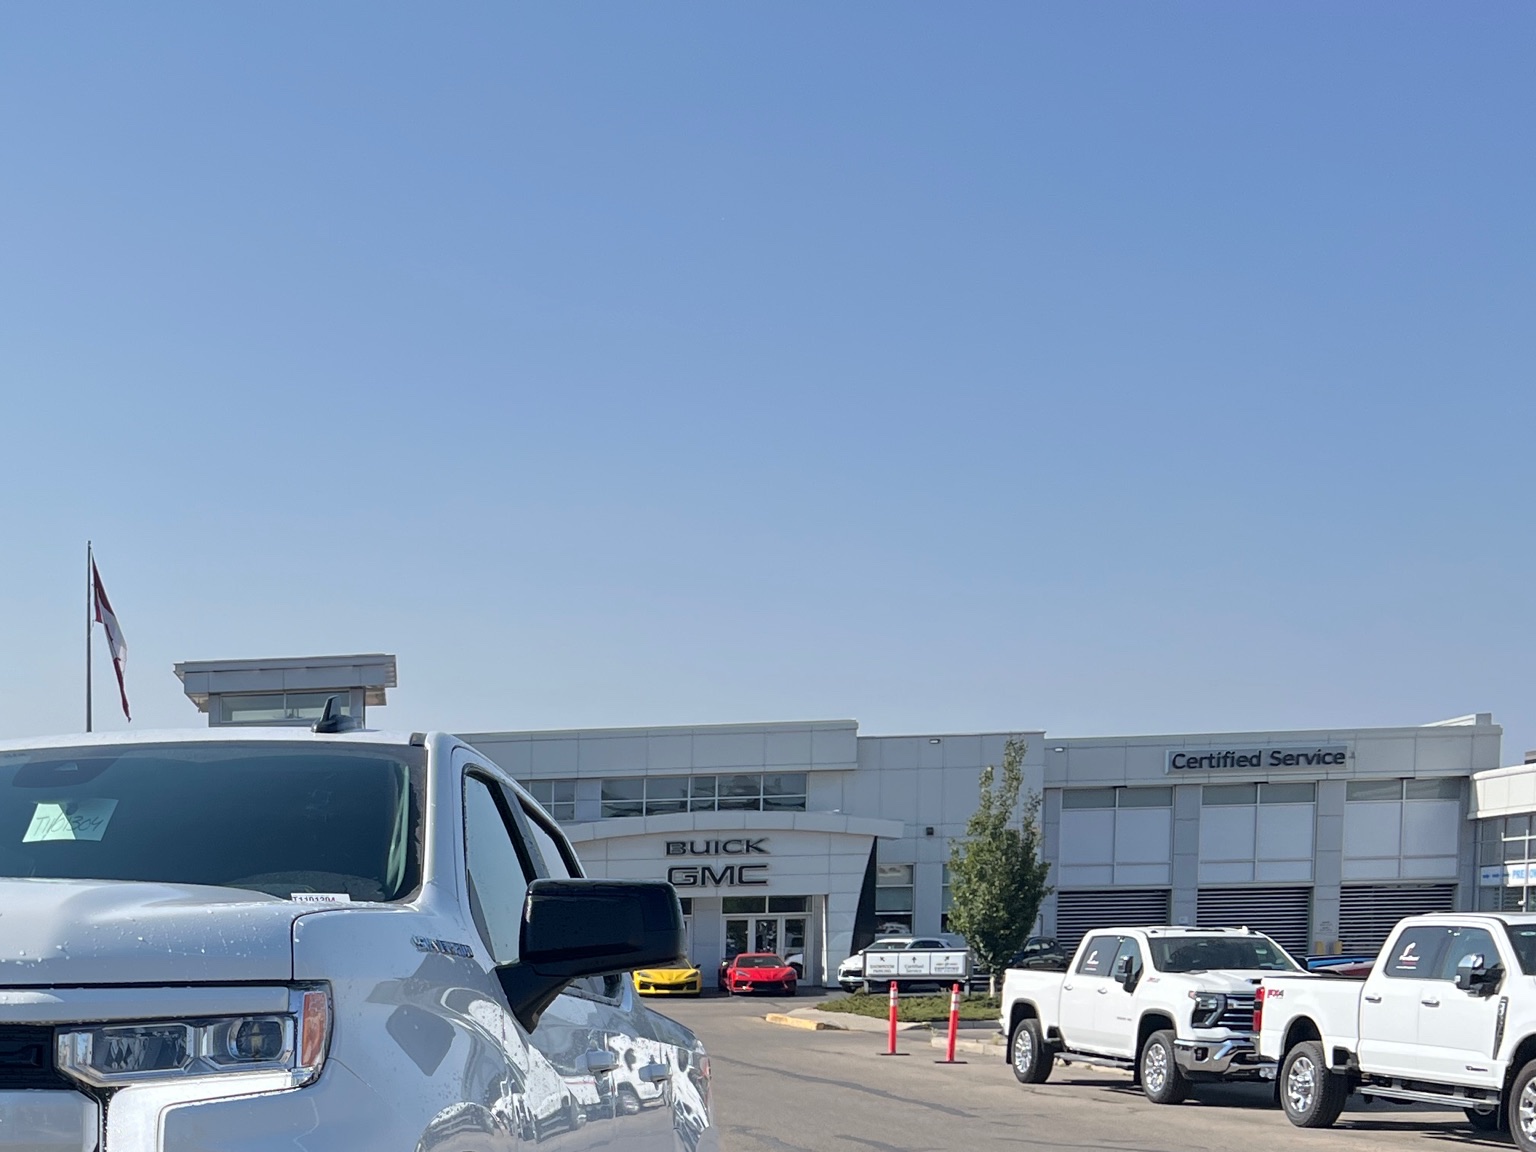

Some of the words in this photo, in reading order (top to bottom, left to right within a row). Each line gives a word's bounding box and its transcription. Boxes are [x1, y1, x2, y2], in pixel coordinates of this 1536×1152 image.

[1172, 751, 1262, 770] Certified
[1269, 749, 1346, 767] Service
[666, 837, 770, 857] BUICK
[667, 863, 769, 888] GMC
